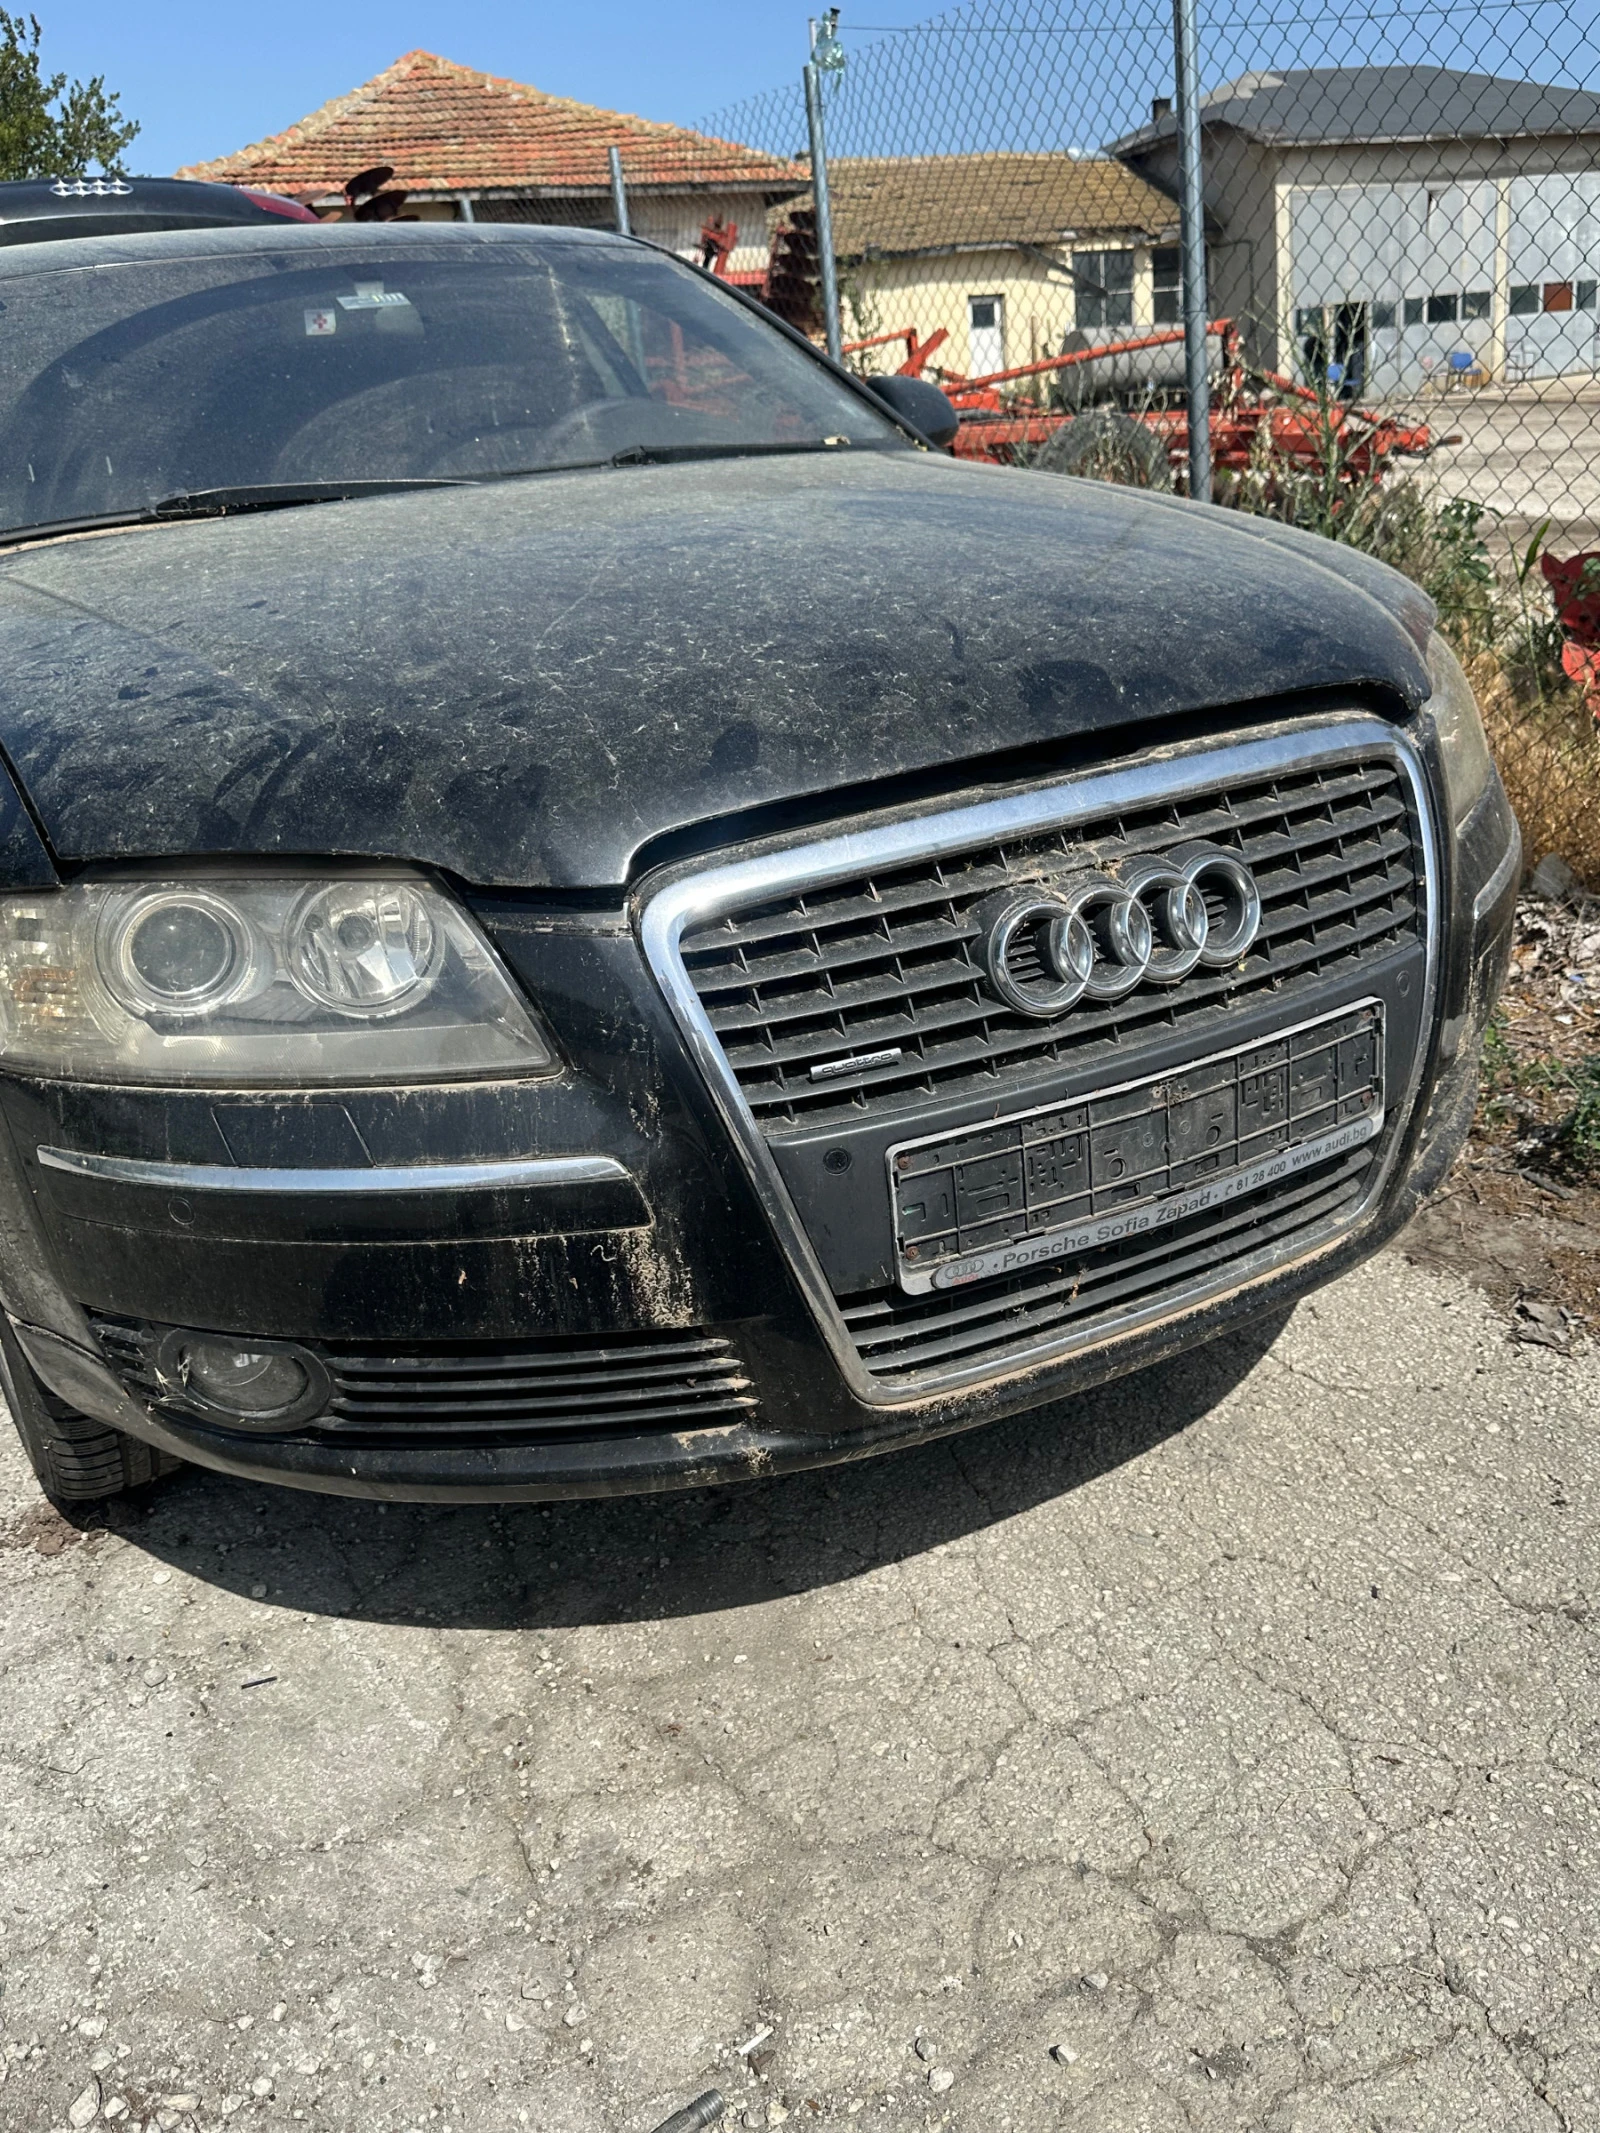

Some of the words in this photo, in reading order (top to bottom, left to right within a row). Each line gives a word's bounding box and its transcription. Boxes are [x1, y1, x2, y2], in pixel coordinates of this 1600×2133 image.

[822, 1052, 893, 1075] quattro
[1003, 1235, 1090, 1268] Porsche
[1097, 1216, 1149, 1241] Sofia
[1155, 1191, 1211, 1223] Zapad
[1236, 1176, 1249, 1191] 81
[1252, 1170, 1265, 1185] 28
[1266, 1160, 1287, 1177] 400
[1291, 1126, 1367, 1167] www.audi.bg
